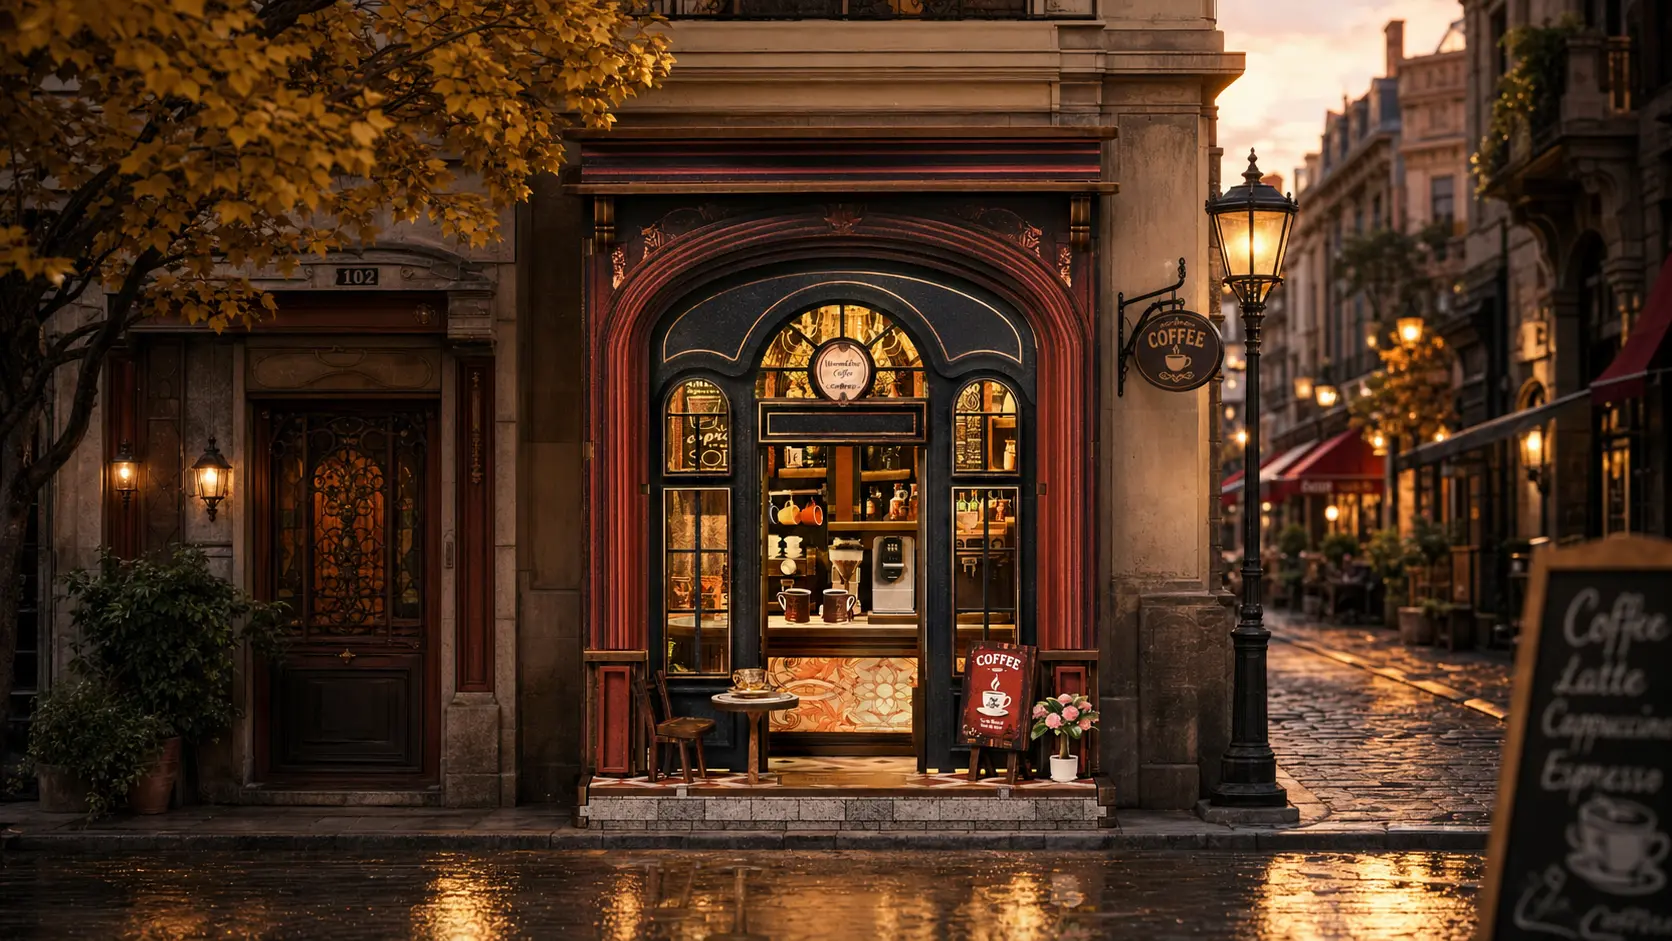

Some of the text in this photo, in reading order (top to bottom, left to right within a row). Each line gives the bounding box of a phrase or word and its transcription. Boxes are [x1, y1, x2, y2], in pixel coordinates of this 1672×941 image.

[344, 269, 375, 284] 102
[1147, 328, 1206, 349] COFFEE
[1563, 587, 1670, 656] Coffee
[976, 653, 1021, 670] COFFEE
[1552, 654, 1647, 696] Latte
